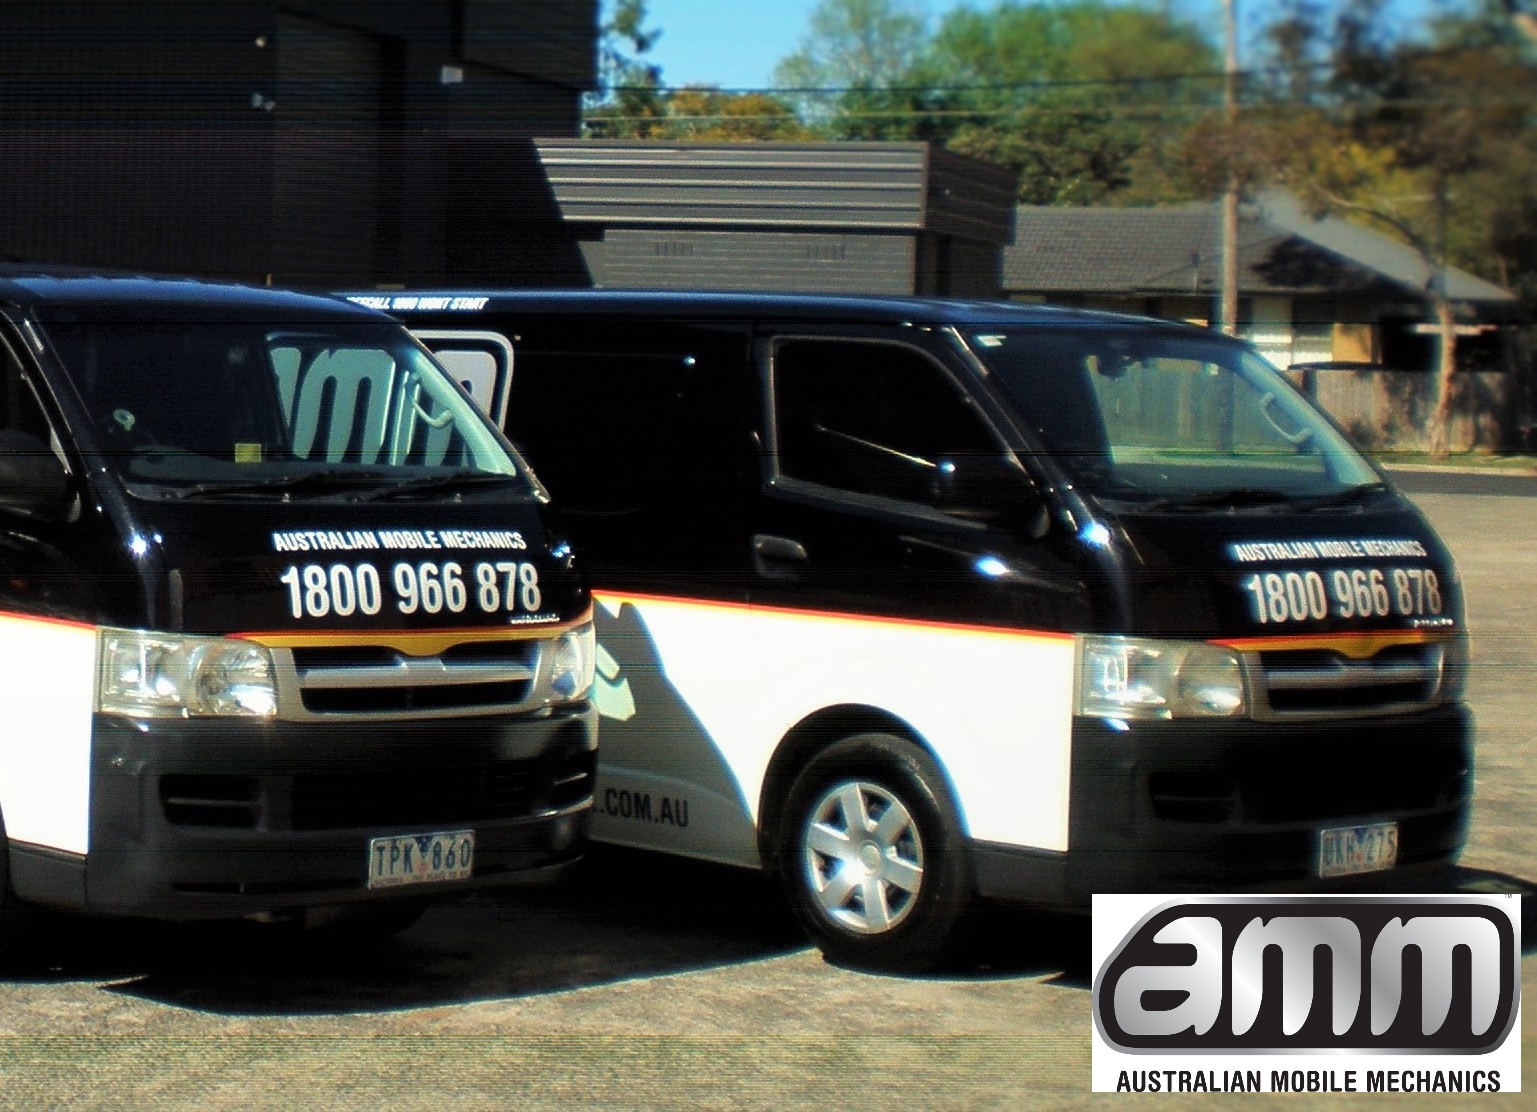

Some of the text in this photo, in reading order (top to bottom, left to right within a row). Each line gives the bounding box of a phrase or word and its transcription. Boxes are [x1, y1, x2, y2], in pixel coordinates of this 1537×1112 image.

[274, 530, 527, 551] AUSTRALIAN MOBILE MECHANICS
[1233, 540, 1428, 562] AUSTRALIAN MOBILE MECHANICS
[281, 562, 542, 618] 1800 966 878
[1249, 568, 1442, 623] 1800 966 878
[375, 838, 471, 876] TPK 860
